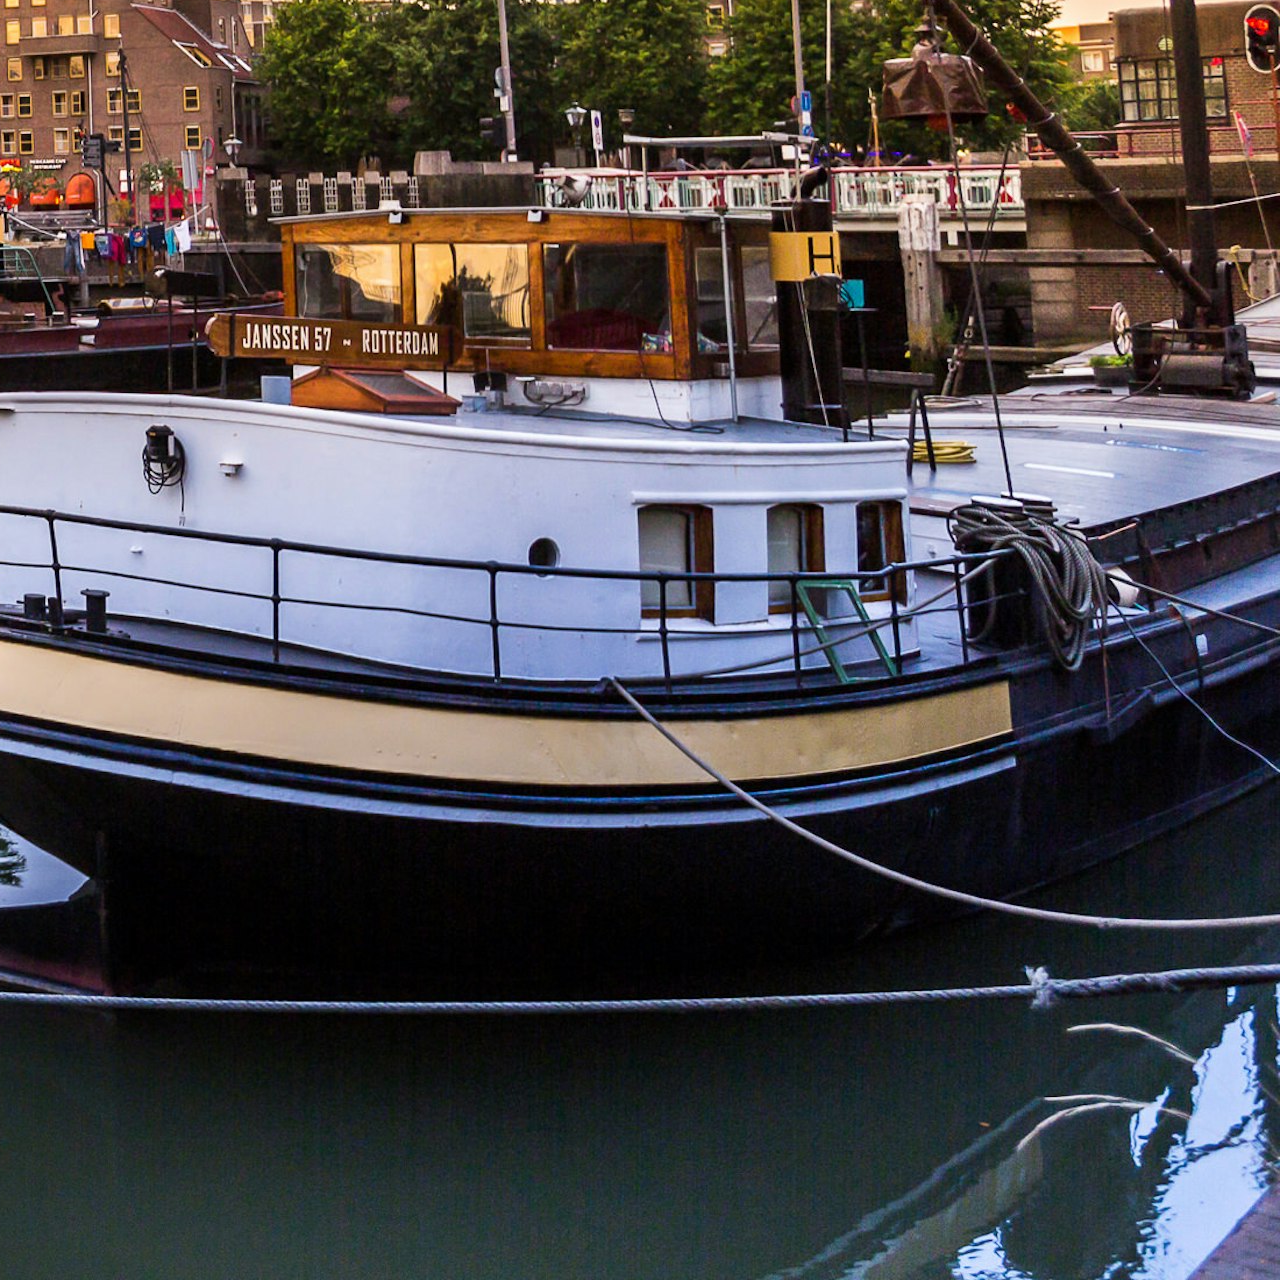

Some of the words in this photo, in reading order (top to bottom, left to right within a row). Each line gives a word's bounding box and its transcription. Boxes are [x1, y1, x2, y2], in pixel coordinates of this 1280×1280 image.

[242, 322, 310, 351] JANSSEN
[314, 327, 332, 352] 57
[362, 328, 439, 355] ROTTERDAM
